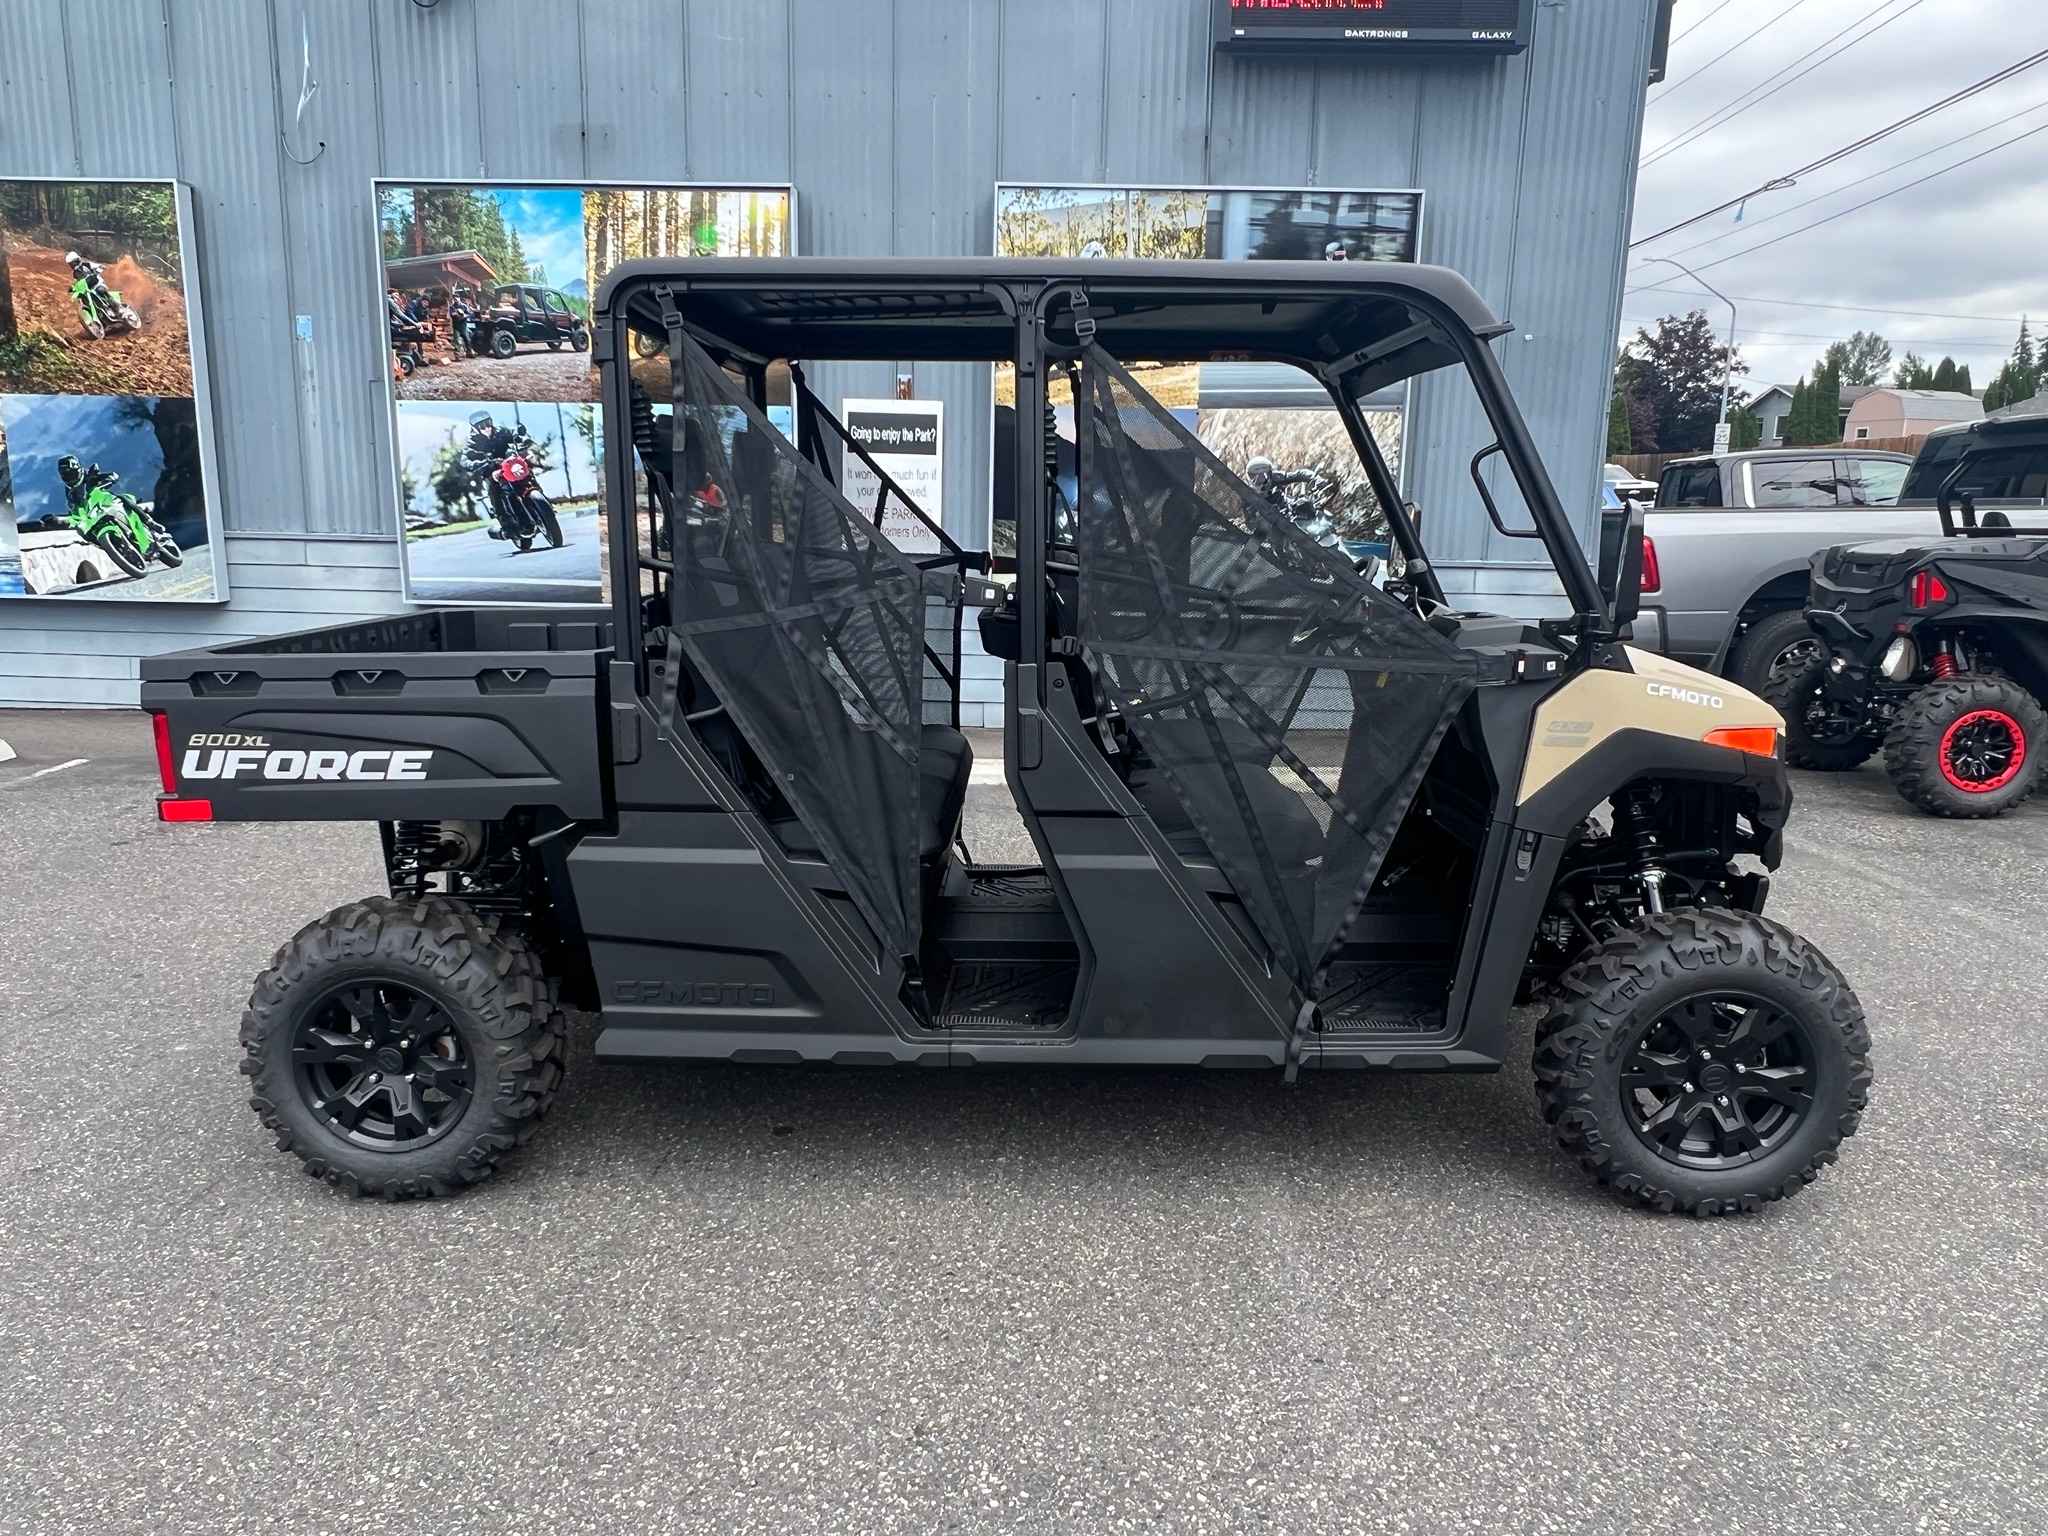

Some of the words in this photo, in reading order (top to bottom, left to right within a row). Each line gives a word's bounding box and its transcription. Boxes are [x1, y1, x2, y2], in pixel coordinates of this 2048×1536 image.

[1344, 29, 1408, 38] DAKTRONICS
[1471, 31, 1513, 39] GALAXY
[850, 425, 872, 443] Going
[873, 427, 881, 441] to
[881, 427, 901, 445] enjoy
[902, 427, 913, 441] the
[915, 427, 936, 443] Park?
[1716, 433, 1728, 441] 25
[892, 467, 914, 481] much
[916, 468, 928, 481] fun
[1646, 682, 1724, 709] CFMOTO
[181, 750, 433, 780] UFORCE
[612, 979, 775, 1006] CFMOTO
